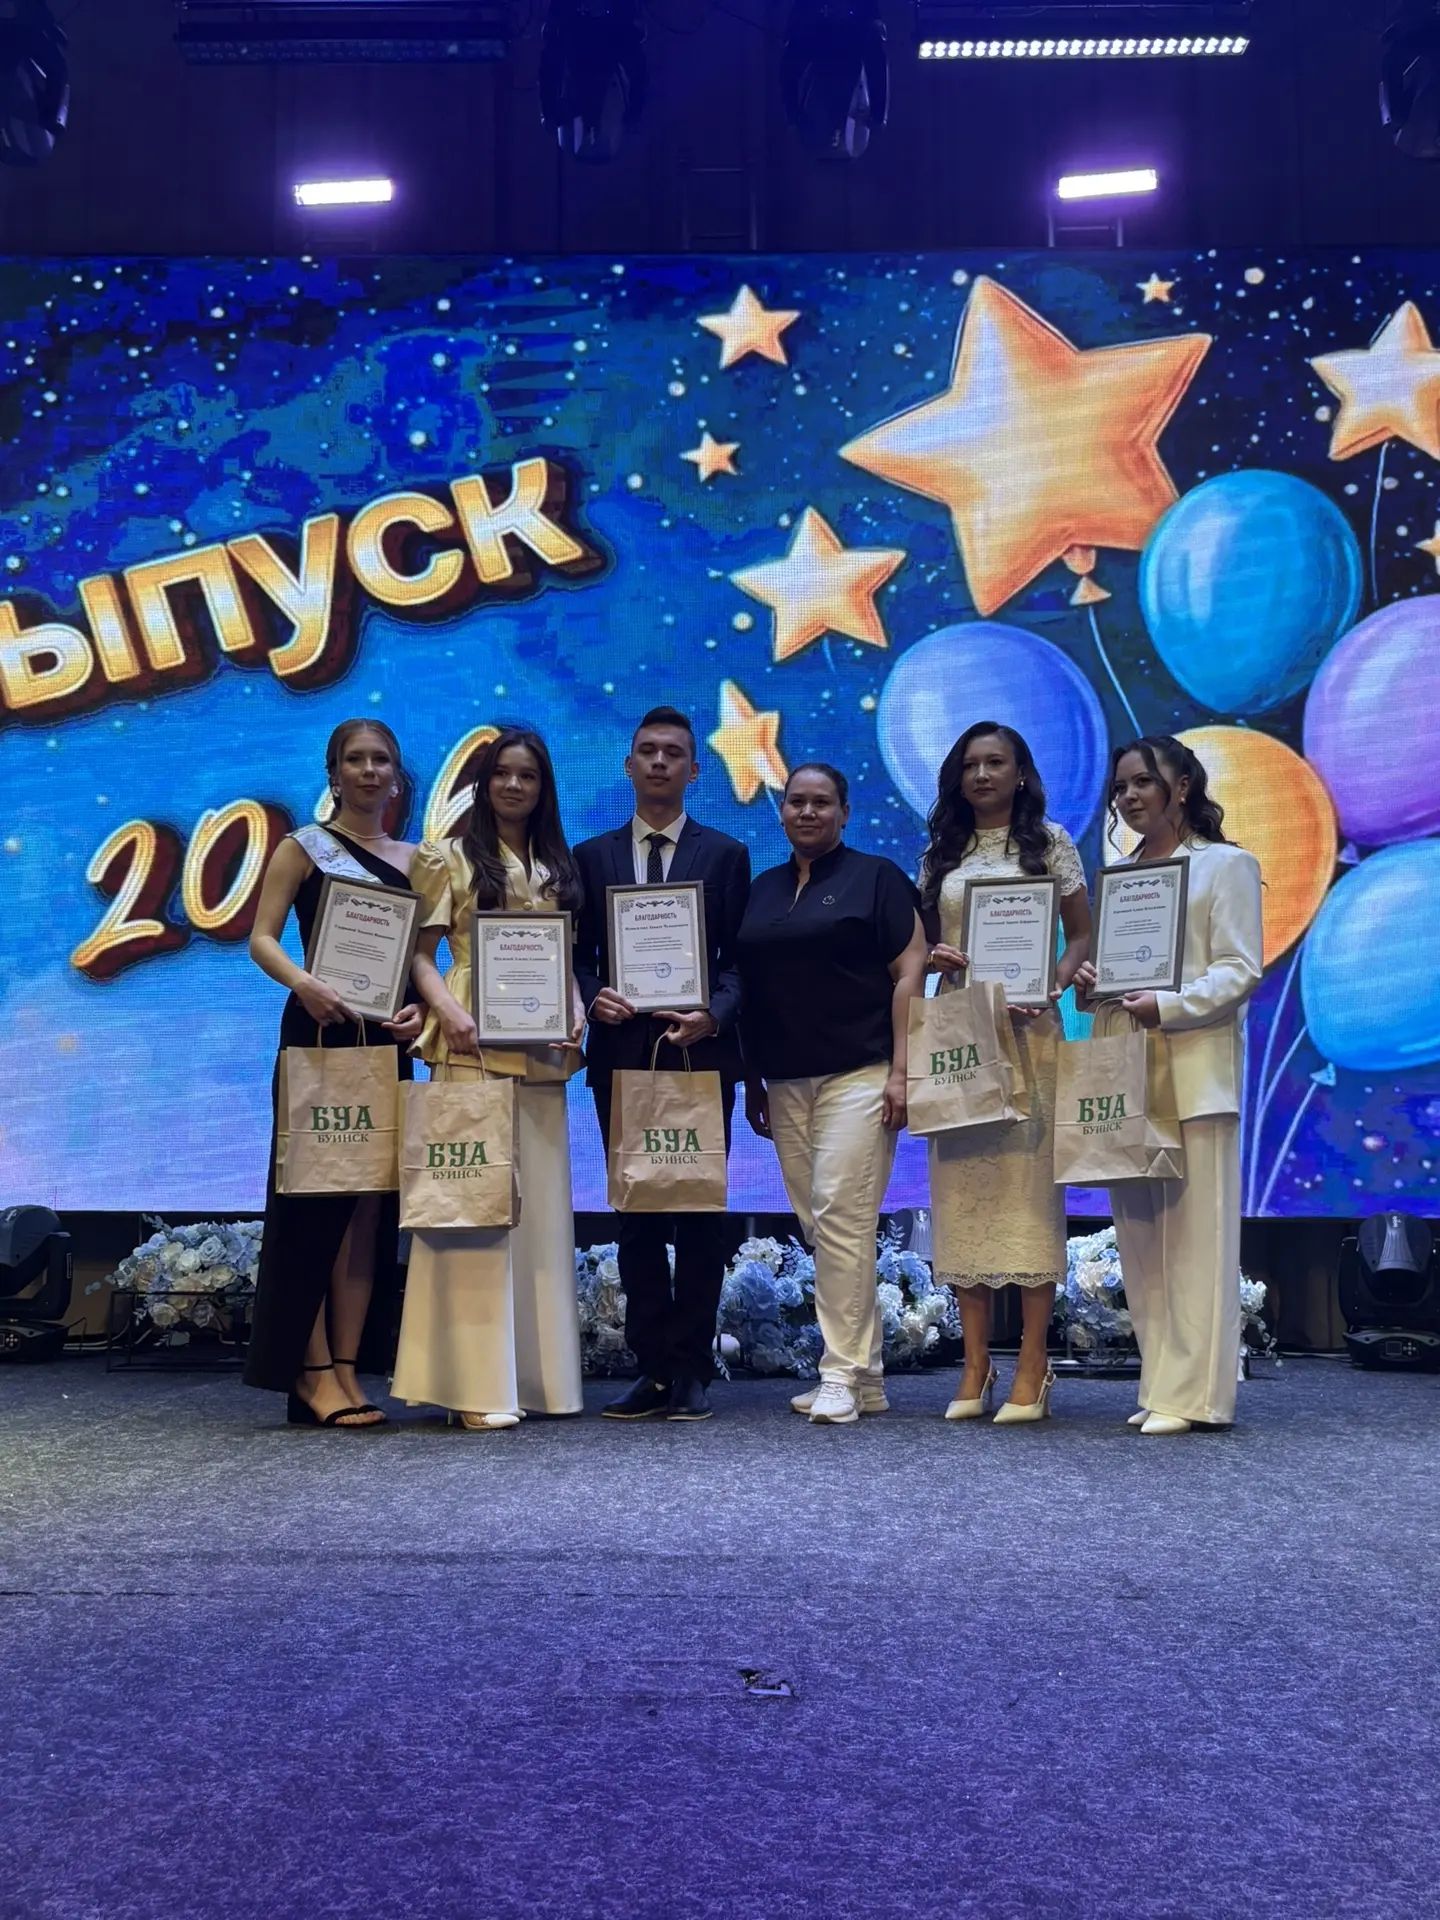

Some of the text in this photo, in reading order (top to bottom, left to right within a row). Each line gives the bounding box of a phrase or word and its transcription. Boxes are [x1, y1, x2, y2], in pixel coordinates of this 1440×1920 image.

[929, 1043, 982, 1076] БУА
[934, 1069, 977, 1086] БУИНСК
[310, 1105, 376, 1131] БУА
[1076, 1093, 1127, 1124] БУА
[317, 1133, 369, 1144] БУИНСК
[1082, 1121, 1122, 1136] БУИНСК
[642, 1128, 703, 1153] БУА
[426, 1141, 489, 1169] БУА
[651, 1155, 698, 1165] БУИНСК
[432, 1168, 482, 1180] БУИНСК
